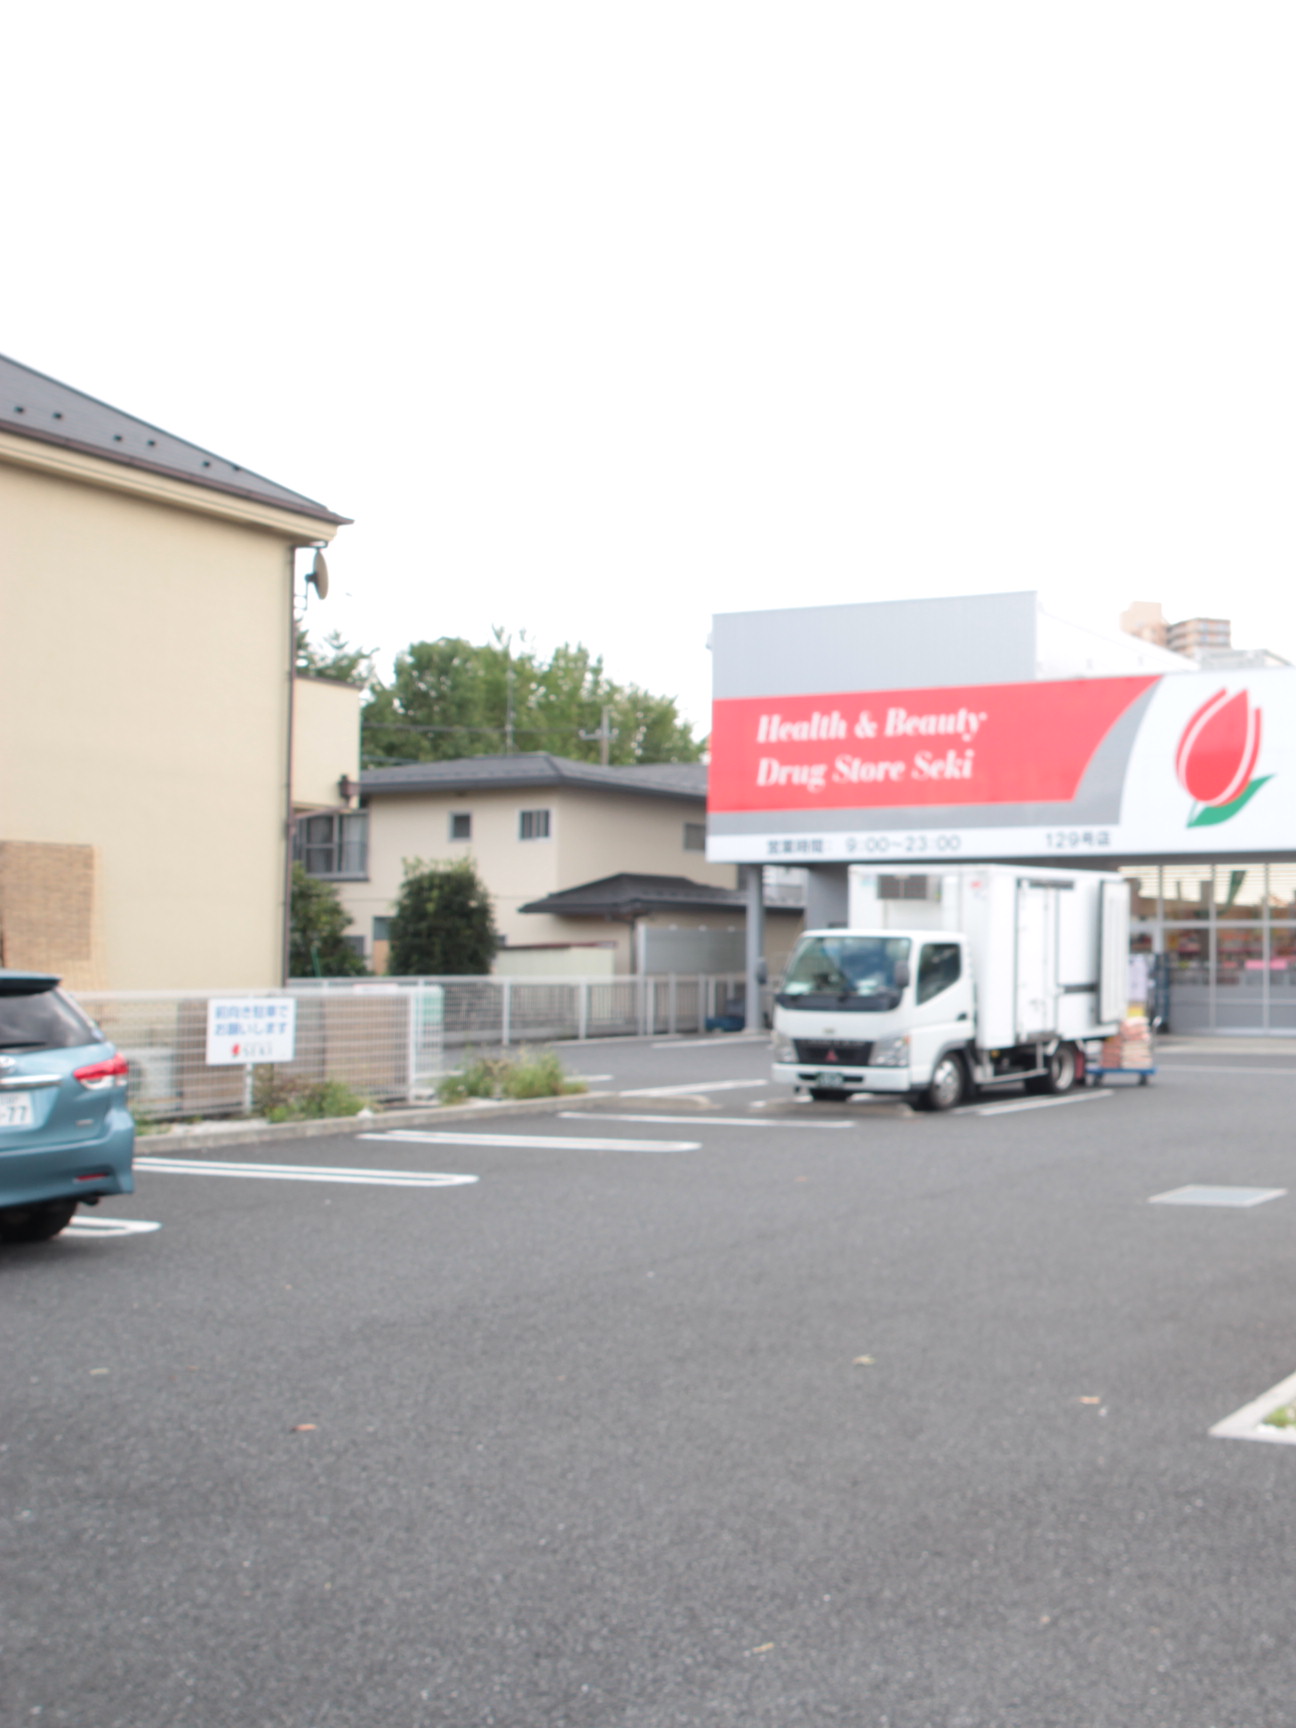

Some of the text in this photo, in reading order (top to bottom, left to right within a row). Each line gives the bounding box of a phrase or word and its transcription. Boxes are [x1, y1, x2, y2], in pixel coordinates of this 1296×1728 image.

[756, 706, 988, 745] Health & Beauty
[756, 749, 974, 793] Drug Store Seki
